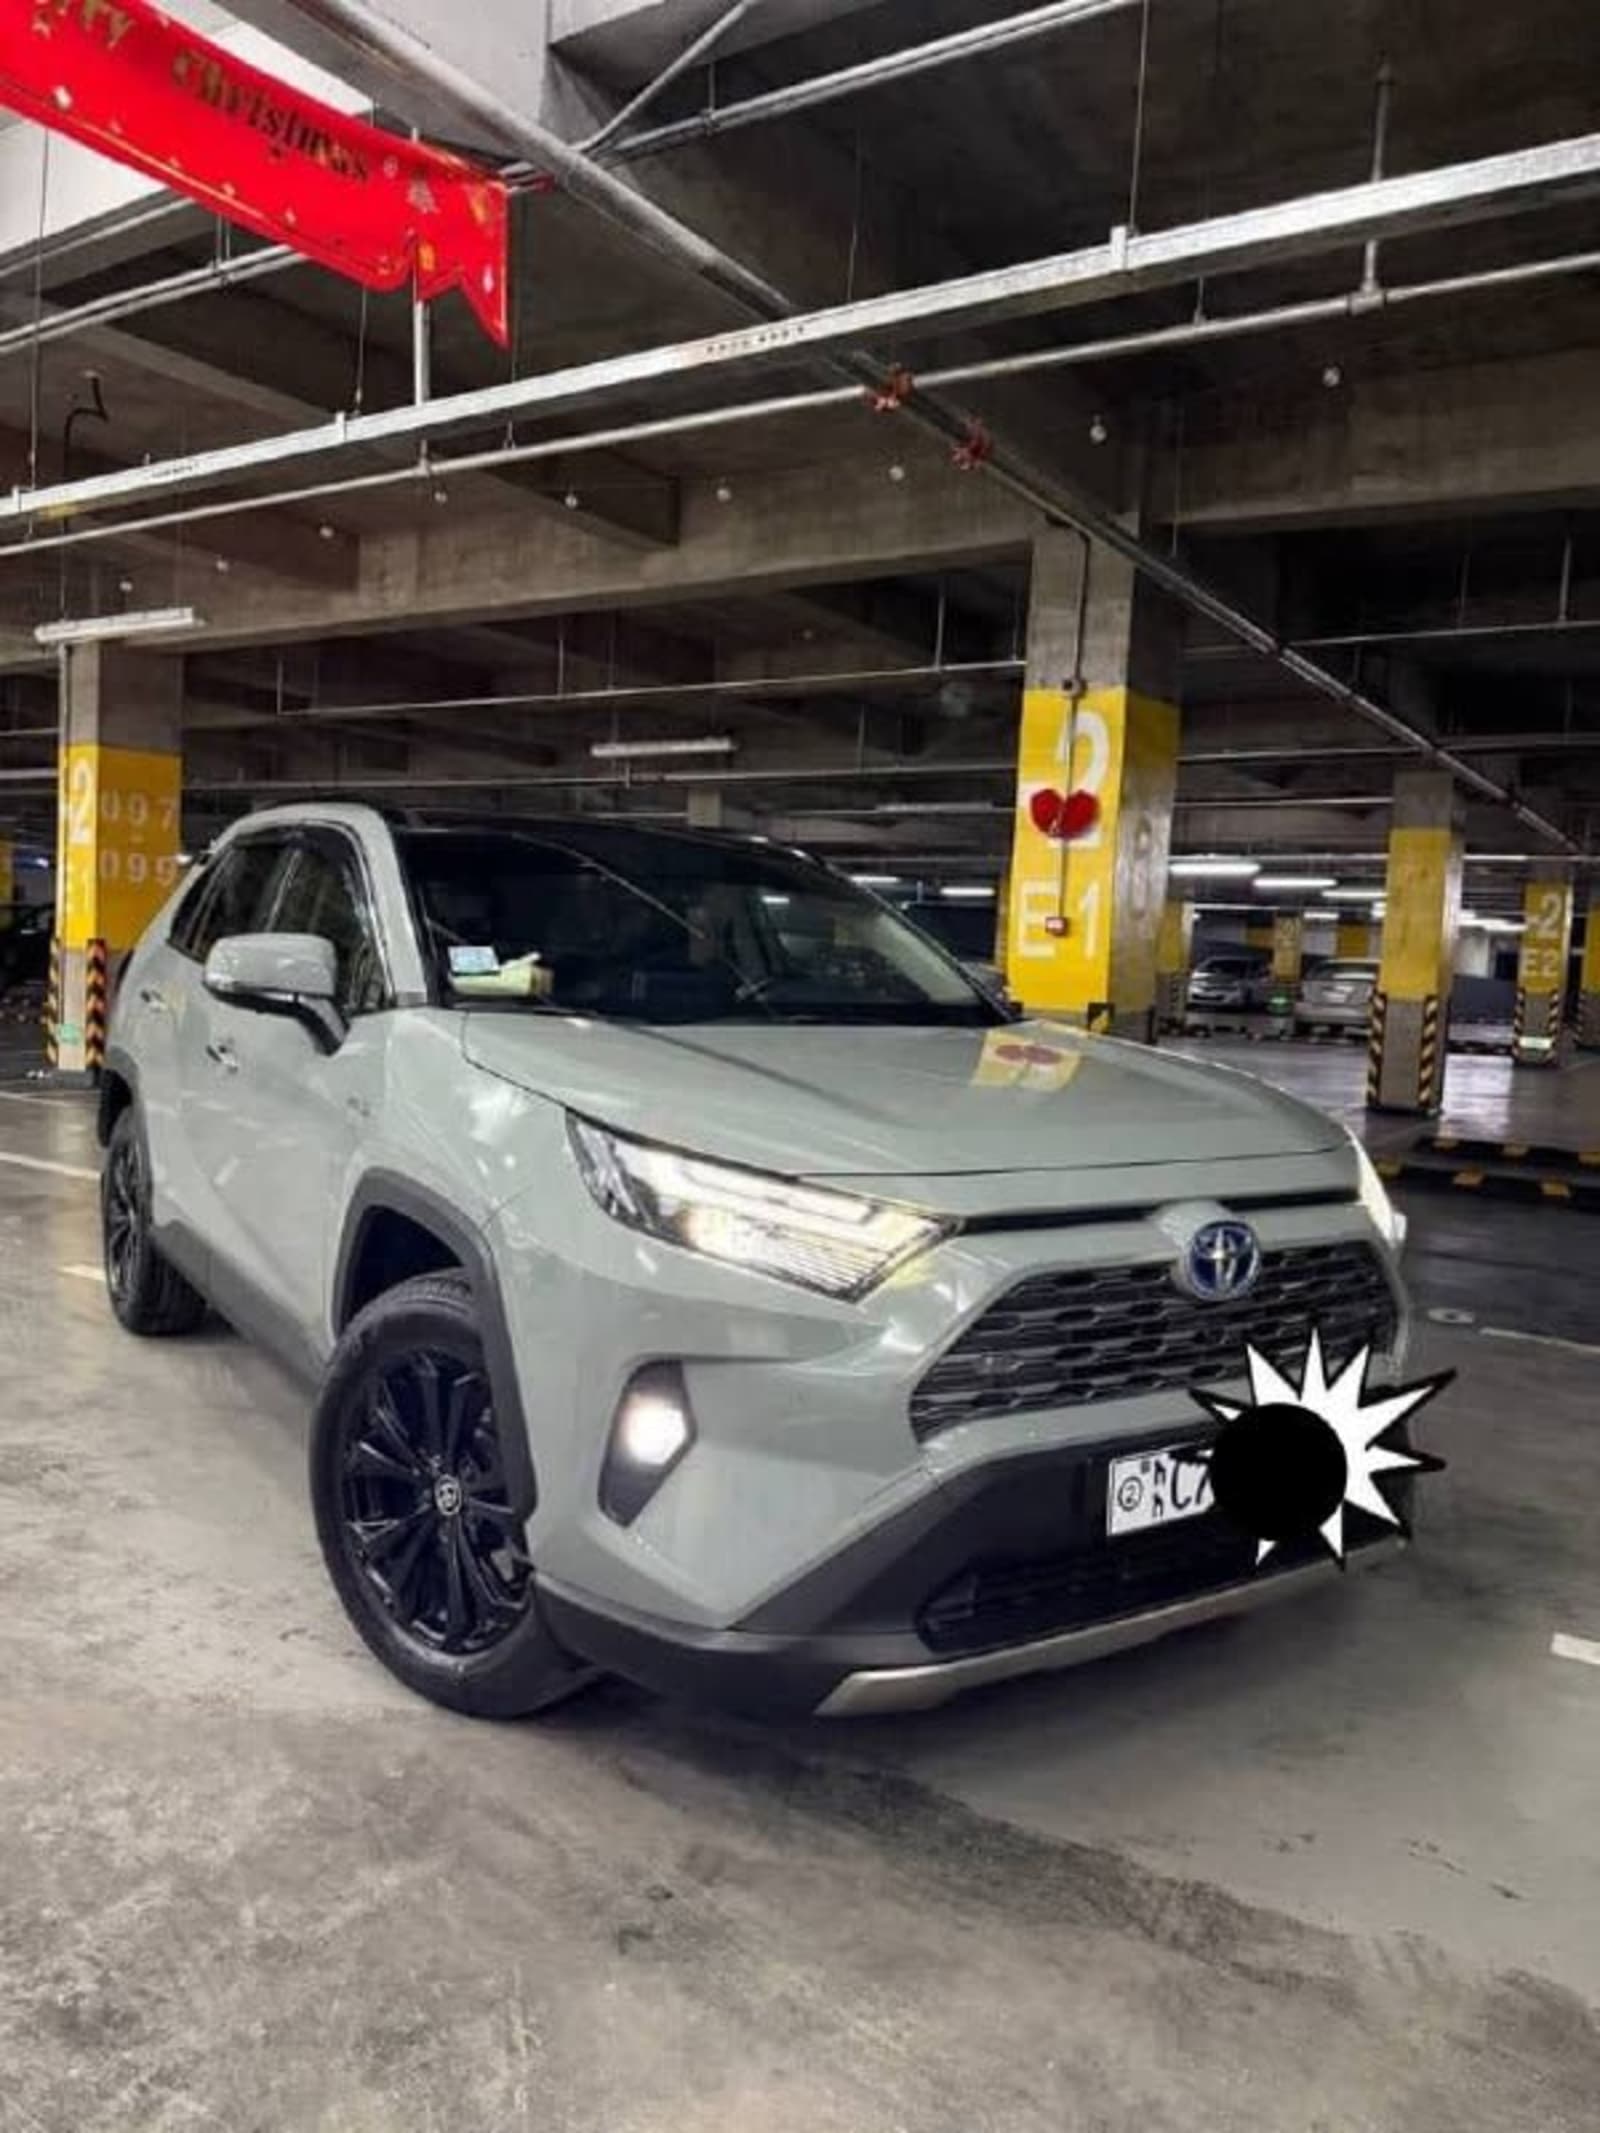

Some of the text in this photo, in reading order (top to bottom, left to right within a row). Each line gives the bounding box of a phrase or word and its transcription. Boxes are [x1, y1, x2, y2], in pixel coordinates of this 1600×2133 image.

[101, 788, 177, 834] 097
[100, 848, 177, 888] 099
[1018, 878, 1102, 958] E1
[1520, 947, 1559, 977] E2
